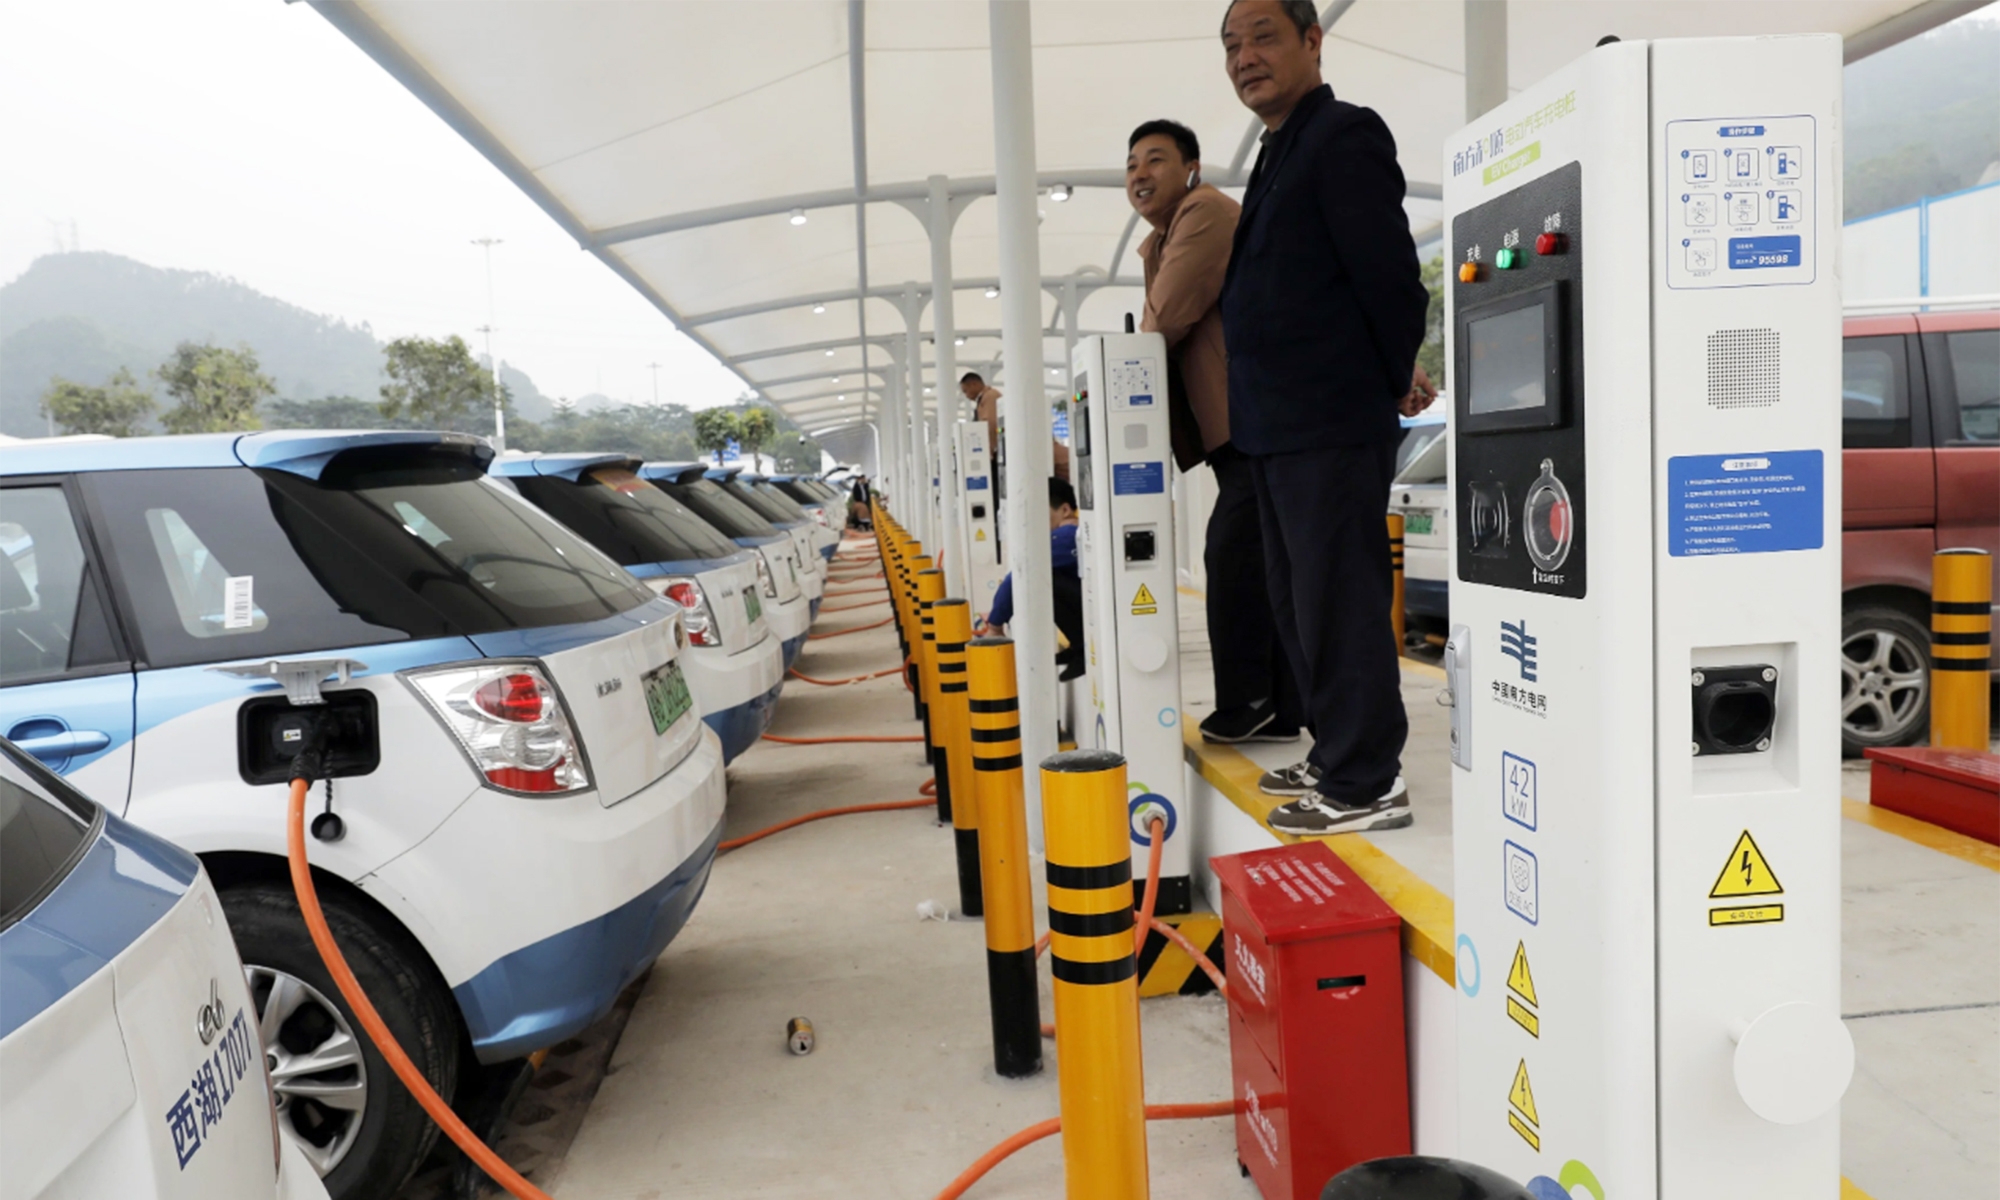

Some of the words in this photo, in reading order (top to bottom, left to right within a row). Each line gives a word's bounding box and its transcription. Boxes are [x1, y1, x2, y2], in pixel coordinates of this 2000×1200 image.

[1491, 679, 1547, 712] 中国南方电网
[1510, 764, 1529, 798] 42
[166, 1006, 252, 1171] 西湖17077
